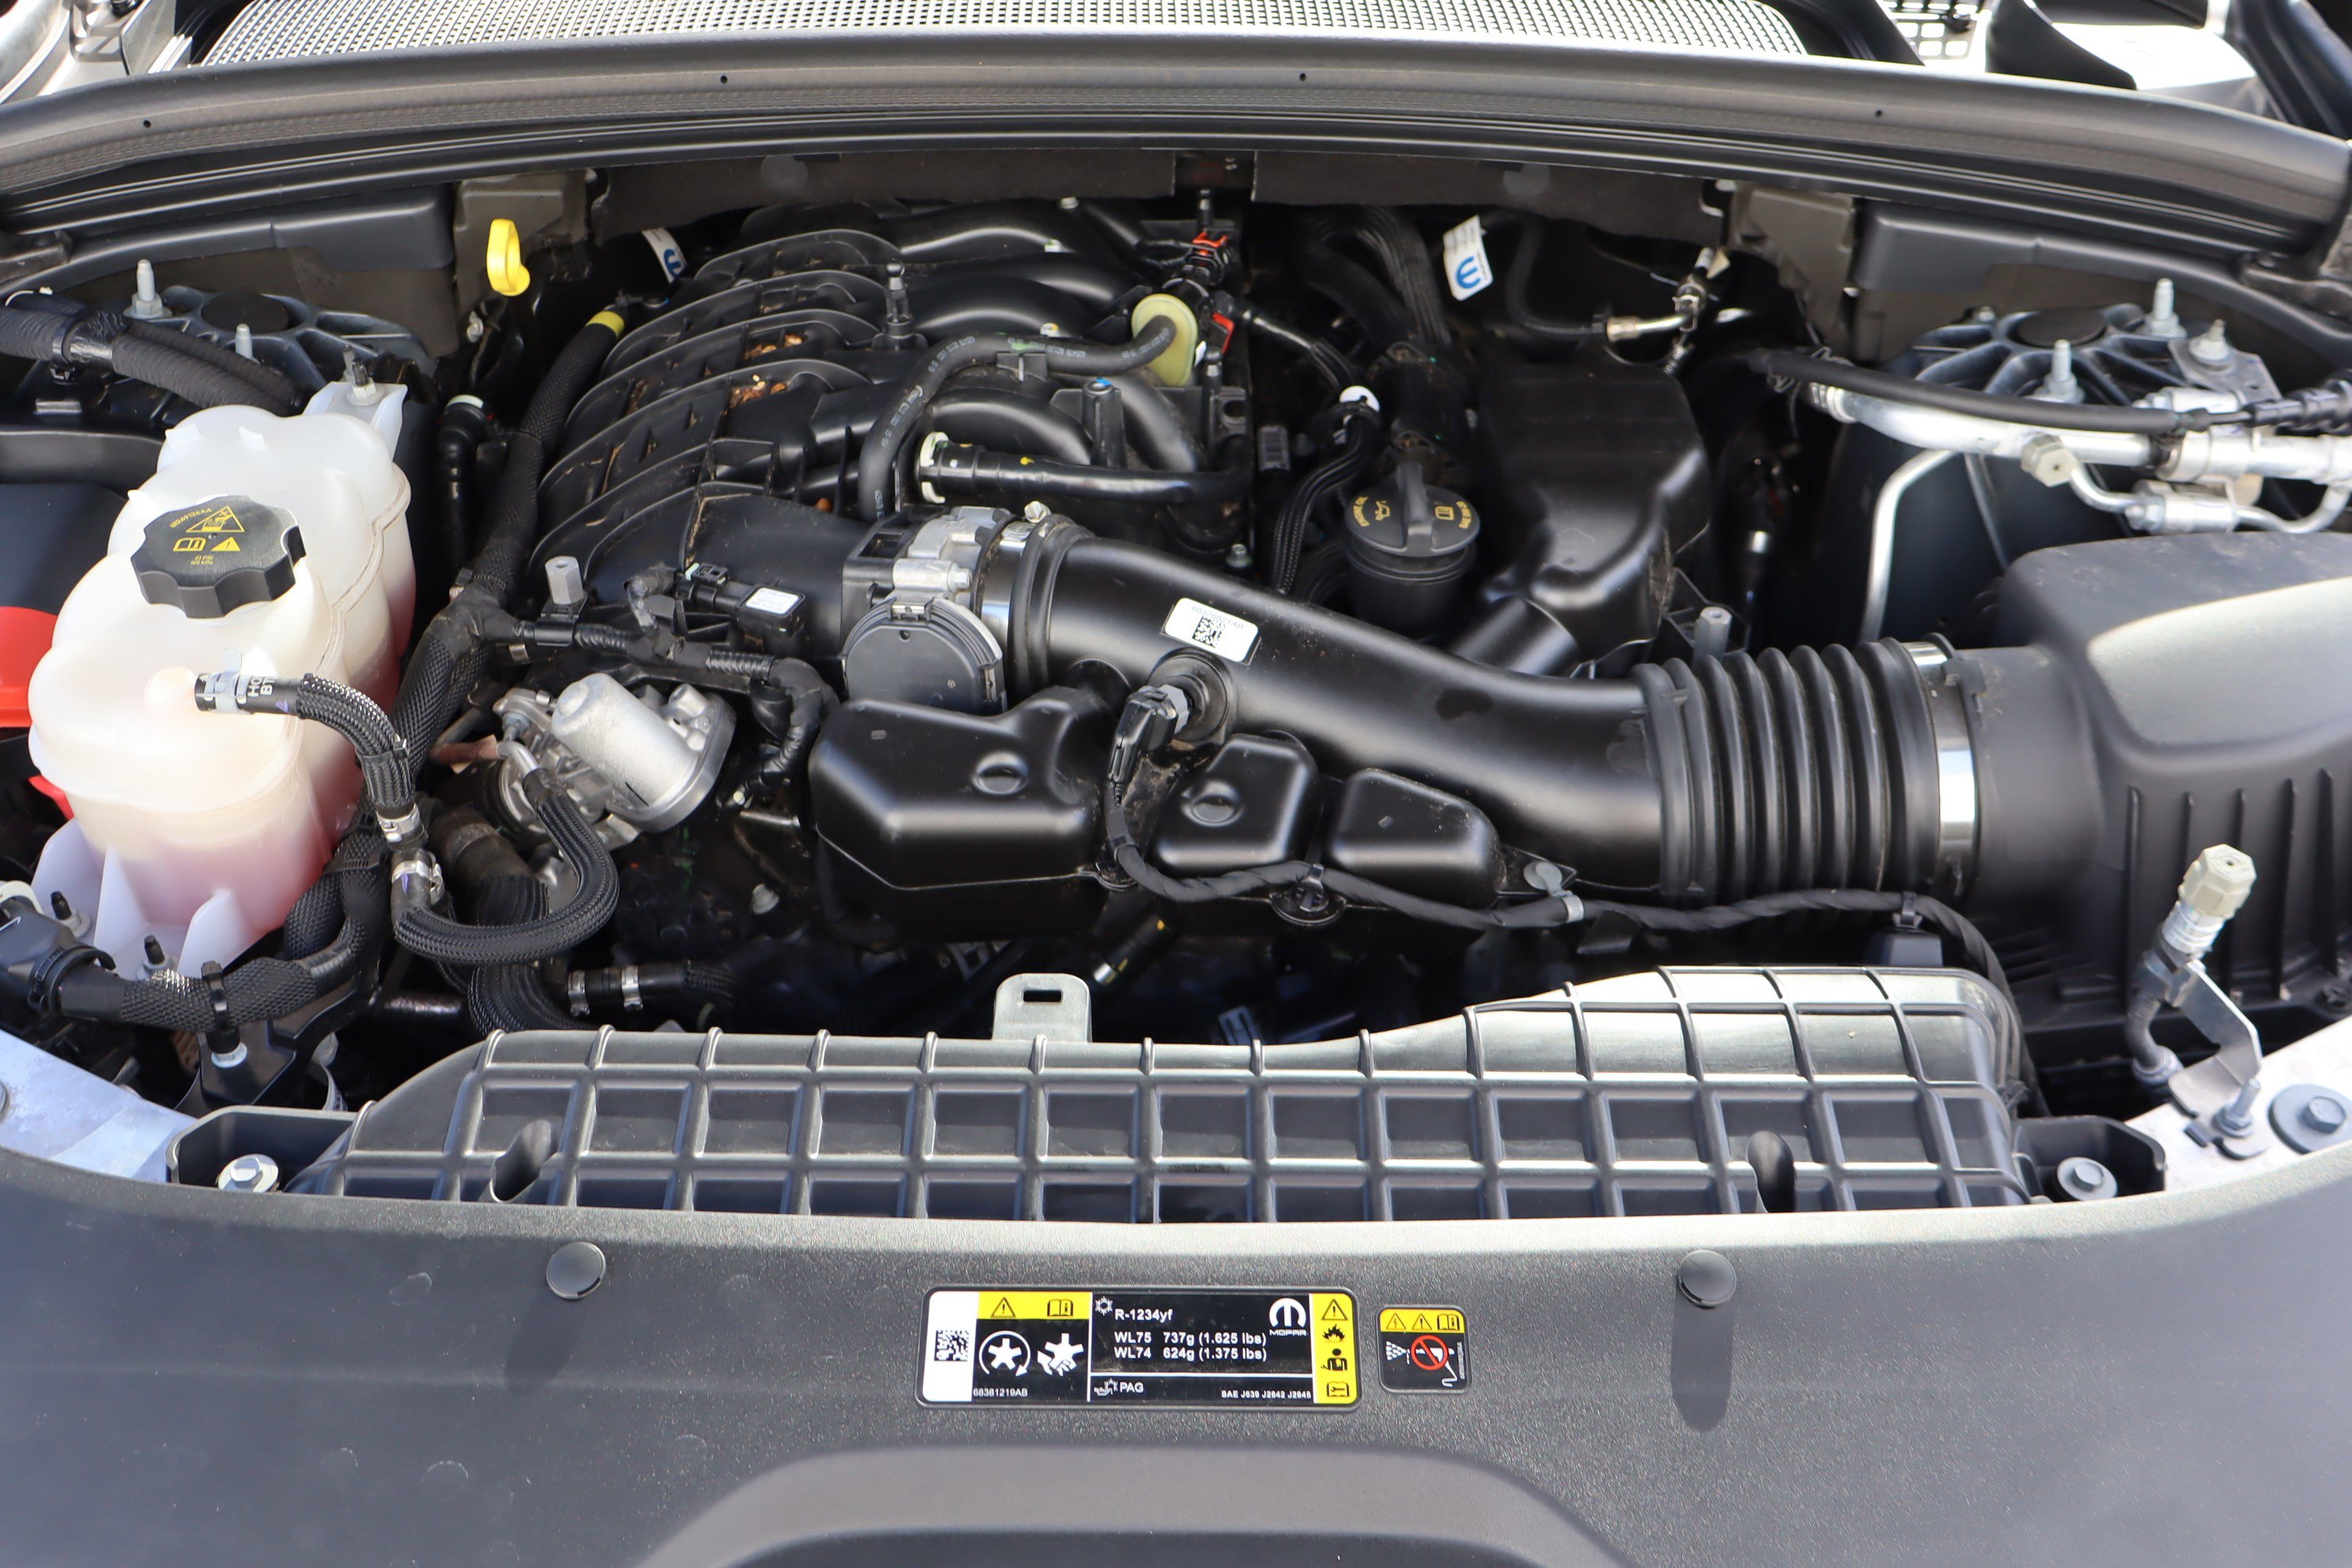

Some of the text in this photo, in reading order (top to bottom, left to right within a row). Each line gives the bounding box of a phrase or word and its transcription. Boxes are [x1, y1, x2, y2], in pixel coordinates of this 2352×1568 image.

[1114, 1308, 1174, 1324] R-1234yf
[1114, 1332, 1267, 1347] WL75 737g (1.625 lbs)
[1114, 1347, 1267, 1362] WL74 624g (1.375 lbs)
[1119, 1381, 1144, 1393] PAG
